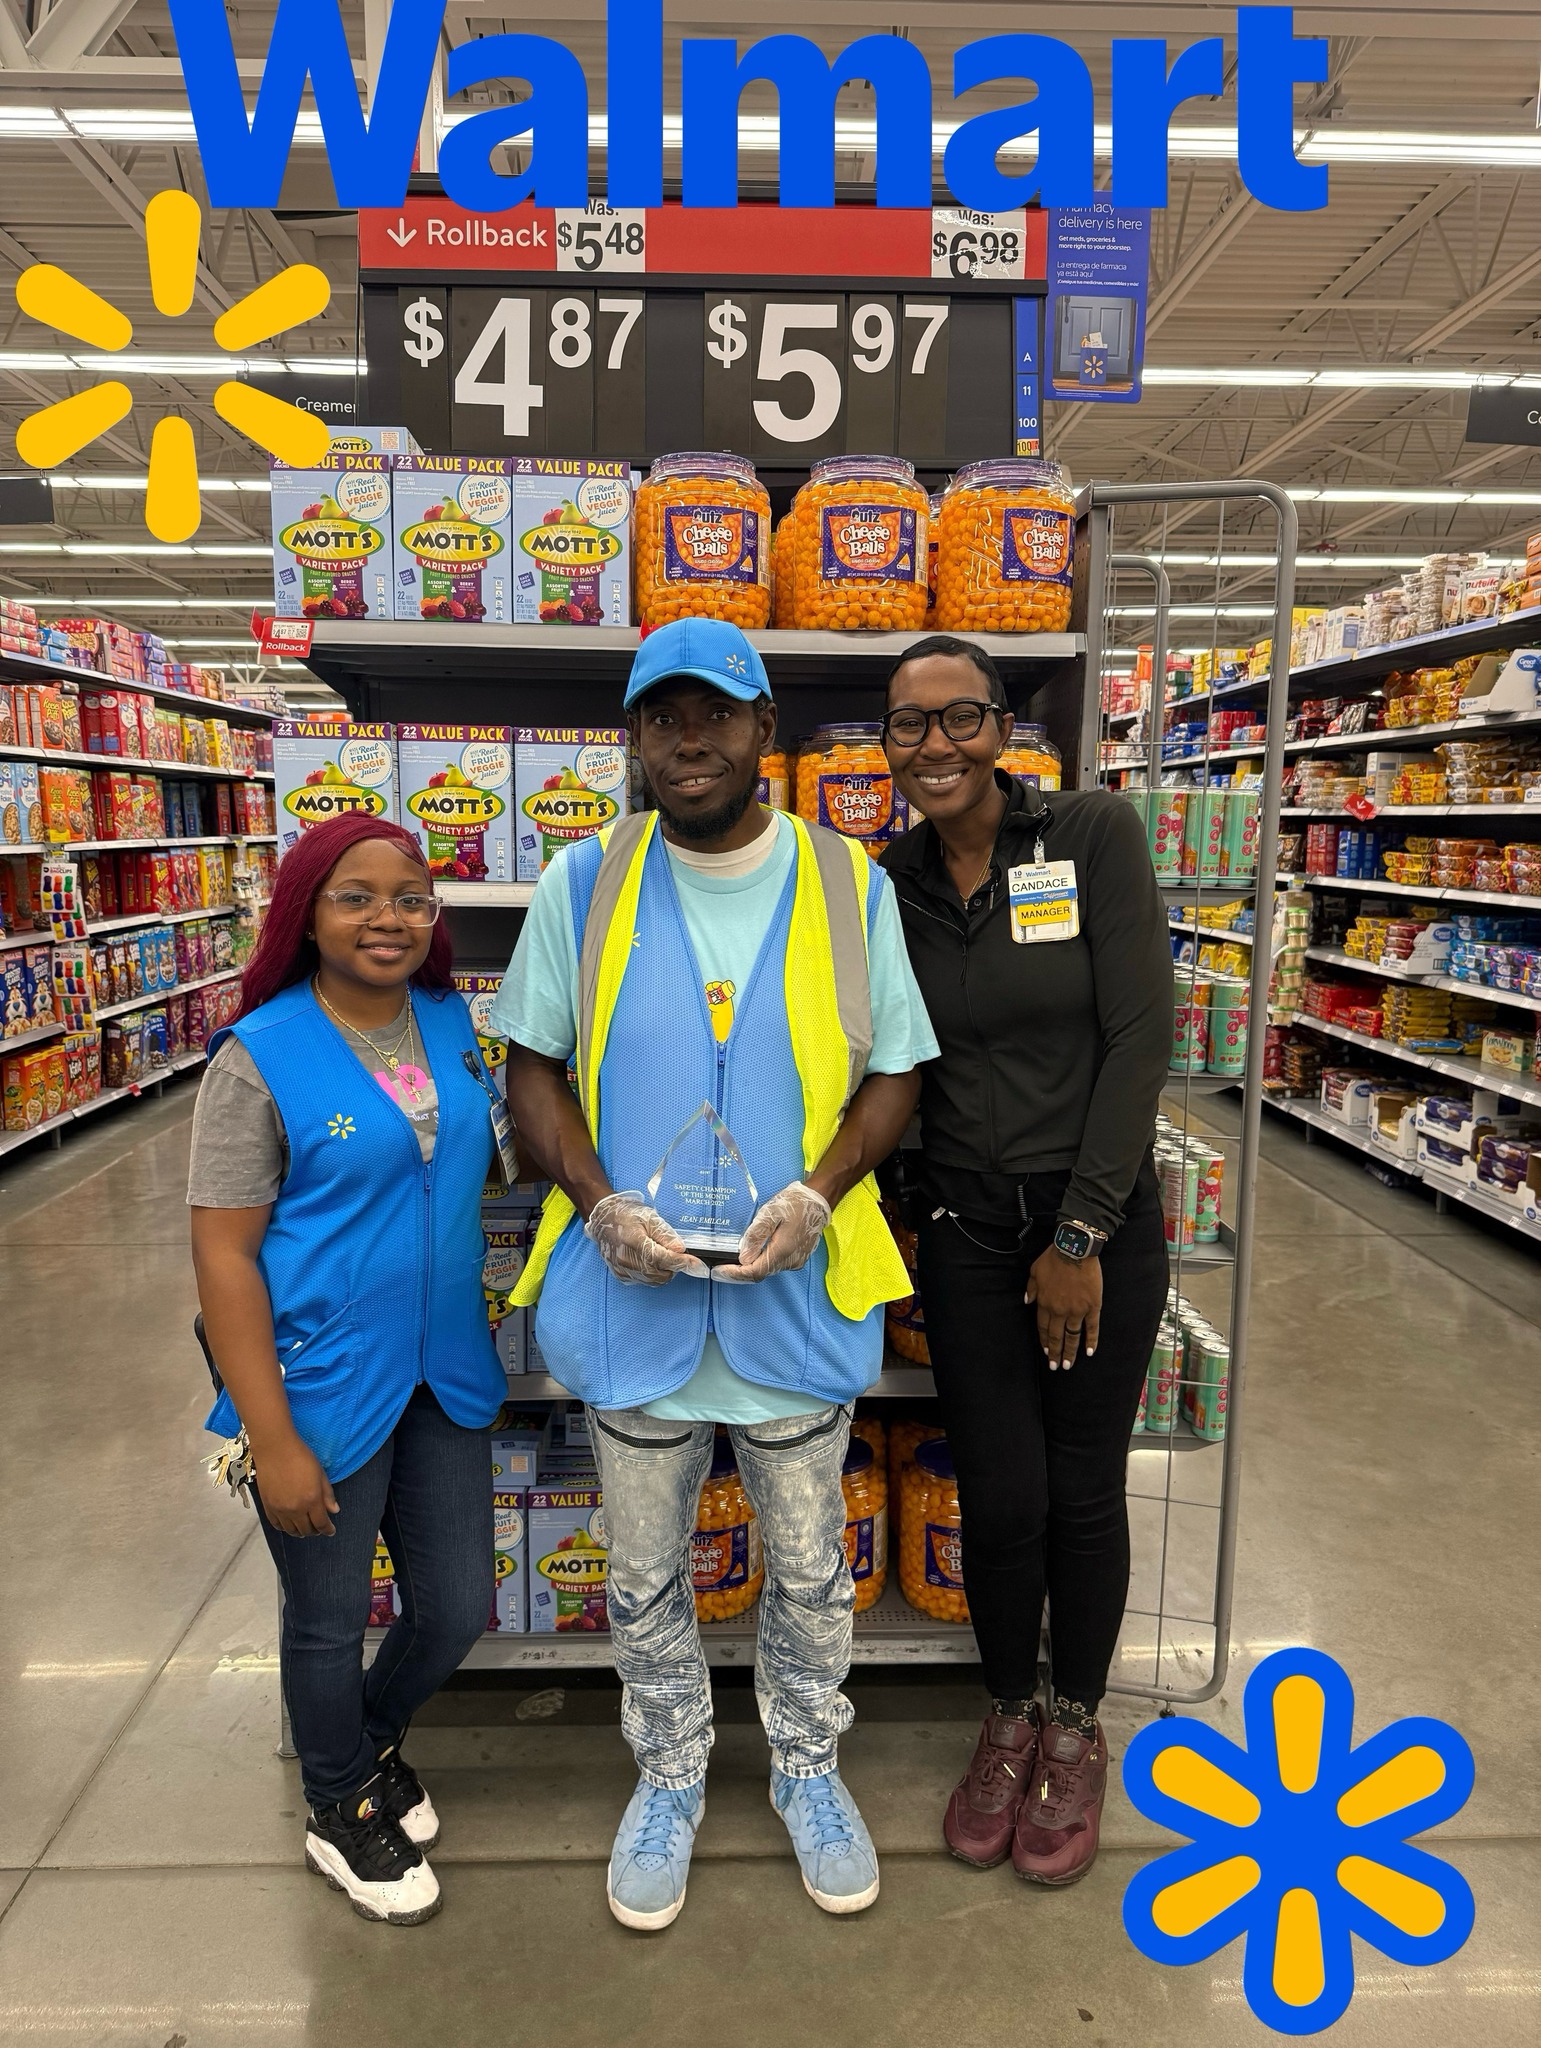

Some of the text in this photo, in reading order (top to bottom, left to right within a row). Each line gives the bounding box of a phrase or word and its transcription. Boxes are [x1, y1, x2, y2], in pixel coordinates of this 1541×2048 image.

[957, 209, 994, 226] Was:
[1058, 216, 1142, 231] delivery is here
[426, 219, 548, 247] Rollback
[1086, 236, 1111, 244] groceries
[1073, 243, 1087, 251] right
[1106, 244, 1132, 252] doorstep.
[1057, 261, 1127, 272] La entrega de farmacia
[1079, 271, 1094, 279] aquí
[1023, 352, 1032, 362] A
[1022, 385, 1031, 396] 11
[1018, 418, 1038, 428] 100
[331, 441, 368, 452] MOTT'S
[345, 456, 384, 470] PACK
[398, 456, 505, 474] 22 VALUE PACK
[517, 460, 623, 477] 22 VALUE PACK
[355, 475, 377, 487] Real
[478, 479, 498, 489] Real
[347, 485, 377, 497] FRUIT
[470, 488, 498, 499] FRUIT
[597, 482, 616, 493] Real
[346, 492, 383, 506] VEGGIE
[468, 496, 504, 508] VEGGIE
[589, 491, 616, 503] FRUIT
[587, 499, 622, 511] VEGGIE
[291, 530, 372, 549] MOTT'S
[683, 525, 732, 543] Cheese
[840, 525, 890, 543] Cheese
[1024, 529, 1064, 546] Cheese
[412, 531, 492, 551] MOTT'S
[531, 535, 610, 555] MOTT'S
[693, 542, 728, 557] Balls
[849, 541, 885, 557] Balls
[1032, 545, 1060, 560] Balls
[301, 557, 365, 571] VARIETY PACK
[421, 560, 484, 572] VARIETY PACK
[540, 562, 602, 576] VARIETY PACK
[398, 591, 405, 600] 22
[266, 642, 306, 652] Rollback
[278, 723, 385, 738] 22 VALUE PACK
[403, 726, 505, 740] 22 VALUE PACK
[519, 729, 620, 743] 22 VALUE PACK
[359, 743, 379, 753] Real
[479, 746, 498, 756] Real
[351, 752, 379, 764] FRUIT
[472, 754, 498, 766] FRUIT
[594, 749, 613, 760] Real
[349, 759, 385, 771] VEGGIE
[470, 761, 504, 774] VEGGIE
[586, 757, 613, 769] FRUIT
[584, 764, 619, 777] VEGGIE
[295, 796, 374, 813] MOTT'S
[418, 797, 493, 815] MOTT'S
[834, 792, 882, 810] Cheese
[533, 800, 607, 817] MOTT'S
[843, 807, 878, 822] Balls
[427, 823, 486, 835] VARIETY PACK
[541, 825, 577, 837] VARIETY
[1025, 870, 1051, 878] Walmart
[1012, 877, 1068, 893] CANDACE
[1021, 906, 1071, 920] MANAGER
[699, 1217, 730, 1225] EMILCAR
[493, 1250, 512, 1261] Real
[486, 1258, 512, 1270] FRUIT
[484, 1264, 517, 1277] VEGGIE
[533, 1495, 546, 1503] 22
[550, 1494, 591, 1506] VALUE
[556, 1583, 589, 1592] VARIETY
